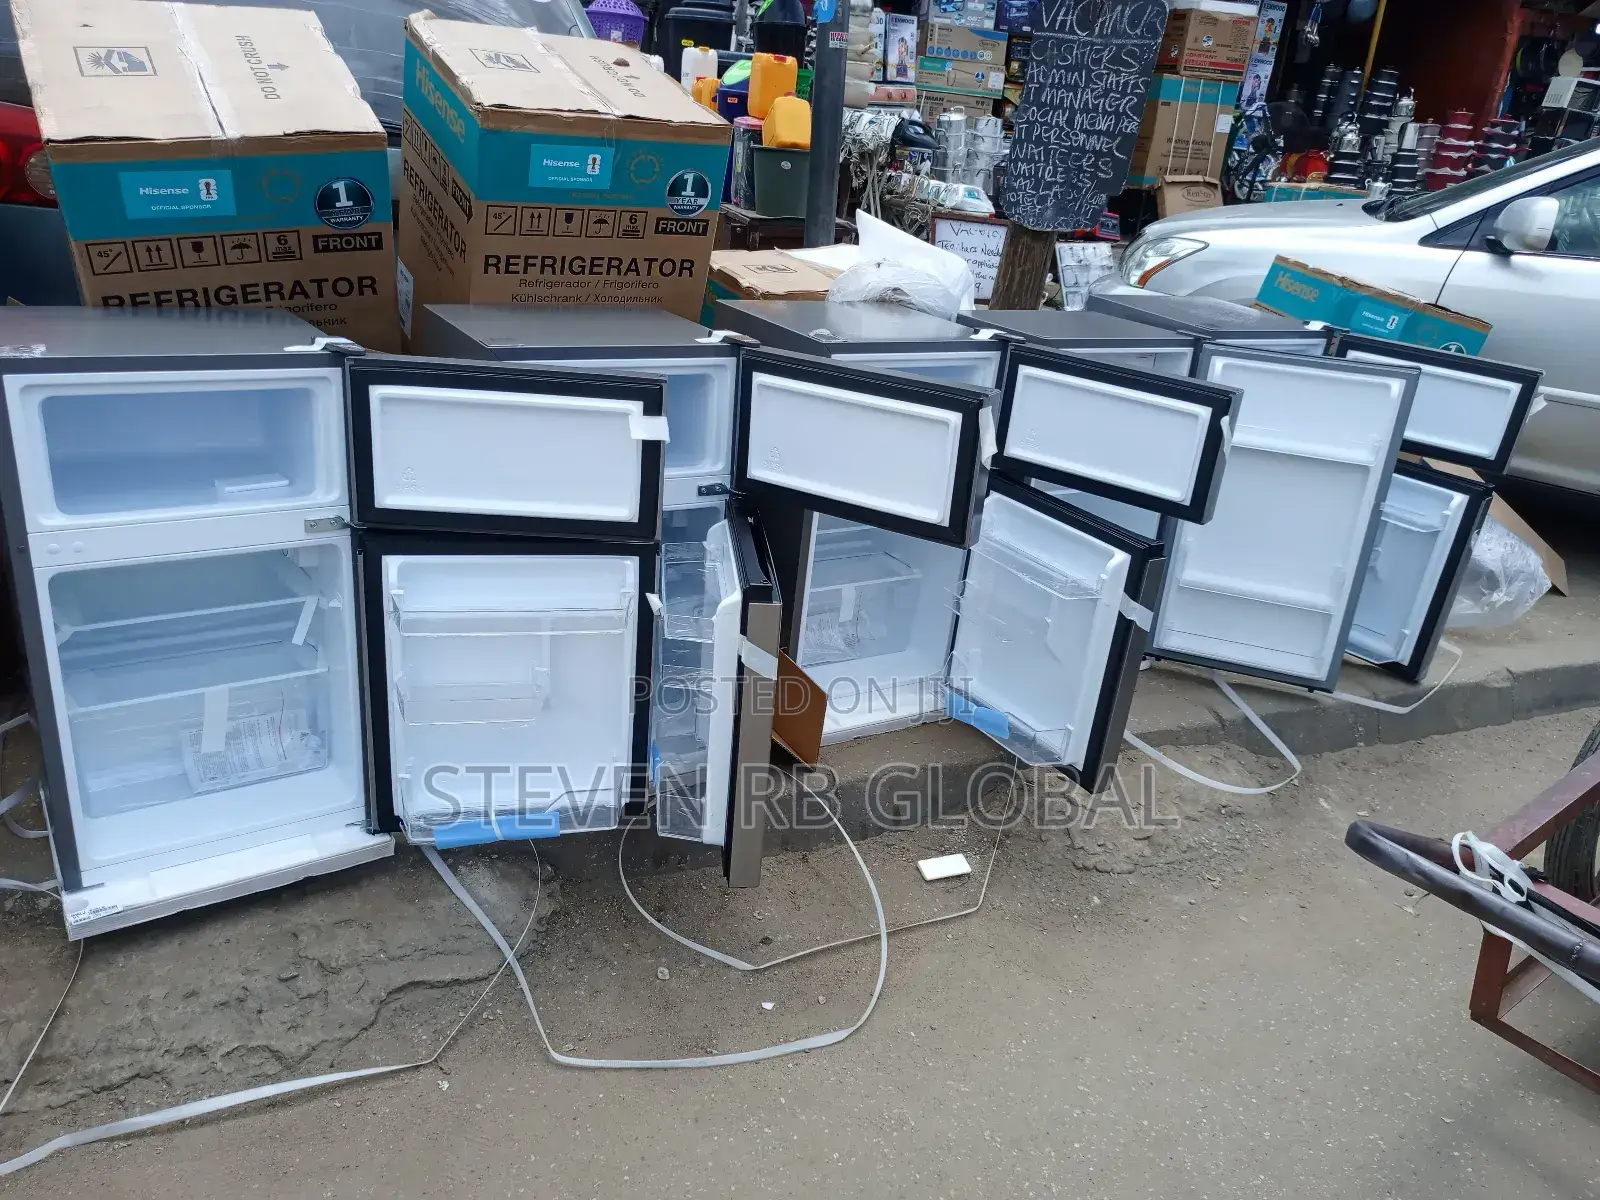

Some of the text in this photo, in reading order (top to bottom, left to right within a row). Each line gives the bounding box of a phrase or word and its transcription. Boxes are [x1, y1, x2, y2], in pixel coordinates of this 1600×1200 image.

[235, 35, 263, 65] CRUSH
[415, 57, 466, 144] Hisense
[1041, 86, 1141, 122] MANAGER
[543, 159, 580, 168] Hisense
[140, 187, 190, 196] Hisense
[681, 173, 696, 196] 1
[332, 181, 354, 208] 1
[675, 197, 699, 205] YEAR
[404, 157, 467, 264] REFRIGERATOR
[629, 213, 638, 225] 6
[658, 220, 707, 233] FRONT
[276, 234, 288, 246] 6
[318, 235, 379, 249] FRONT
[483, 254, 697, 278] REFRIGERATOR
[518, 278, 592, 290] Refrigerador
[603, 279, 660, 291] Frigorifero
[1273, 270, 1320, 303] Hisense
[511, 293, 583, 304] Kühlschrank
[594, 294, 664, 305] Холодильник
